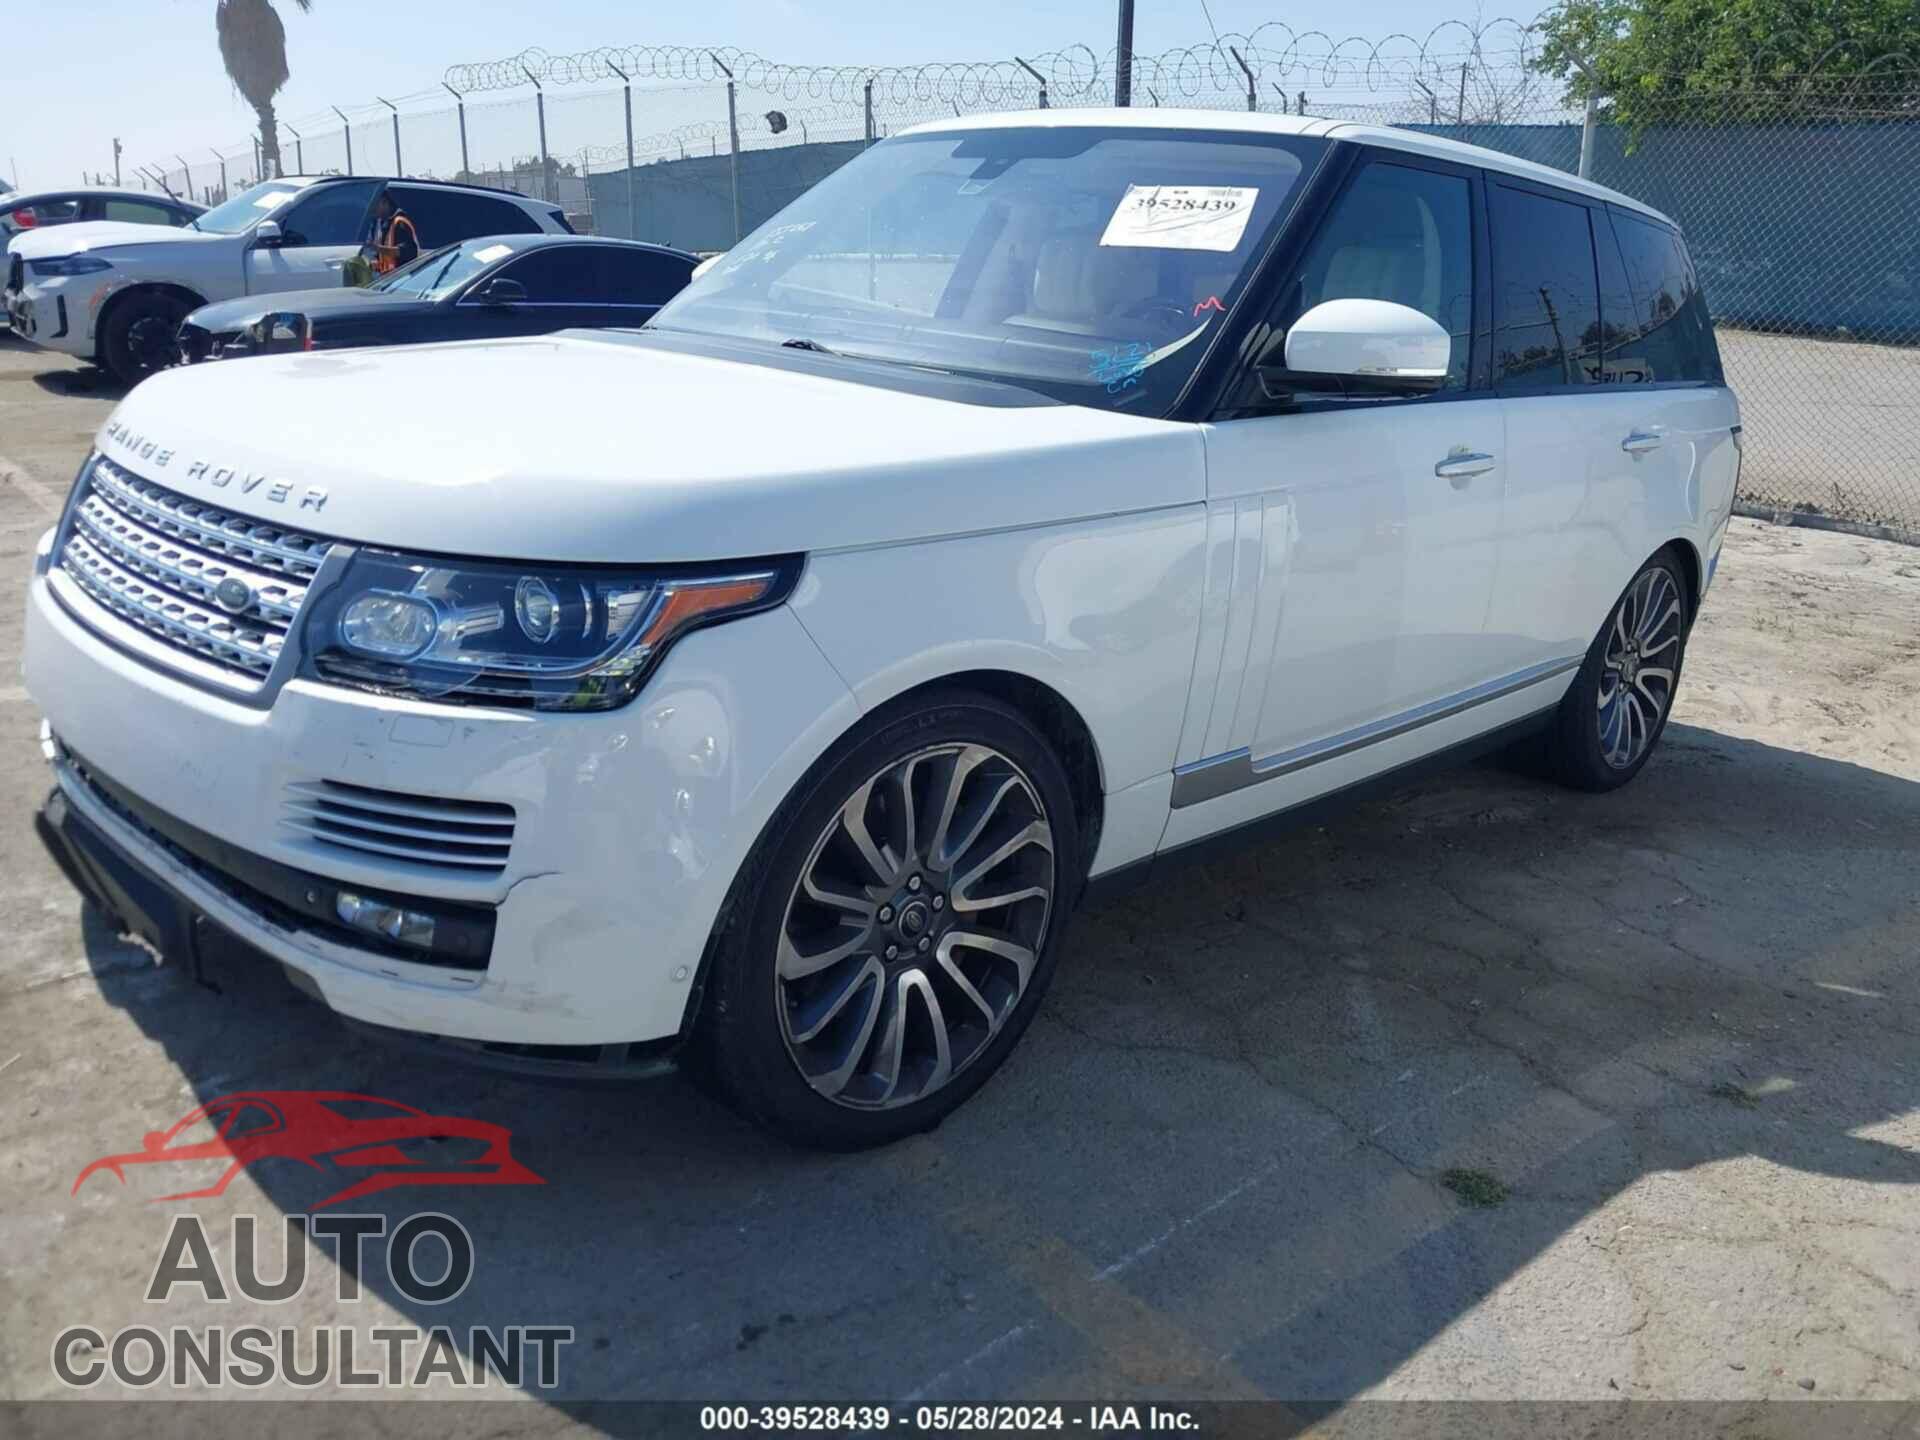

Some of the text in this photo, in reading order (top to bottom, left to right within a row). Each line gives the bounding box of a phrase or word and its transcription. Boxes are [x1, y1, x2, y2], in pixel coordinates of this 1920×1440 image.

[1131, 198, 1236, 212] 39528439
[106, 422, 328, 512] RANGE ROVER
